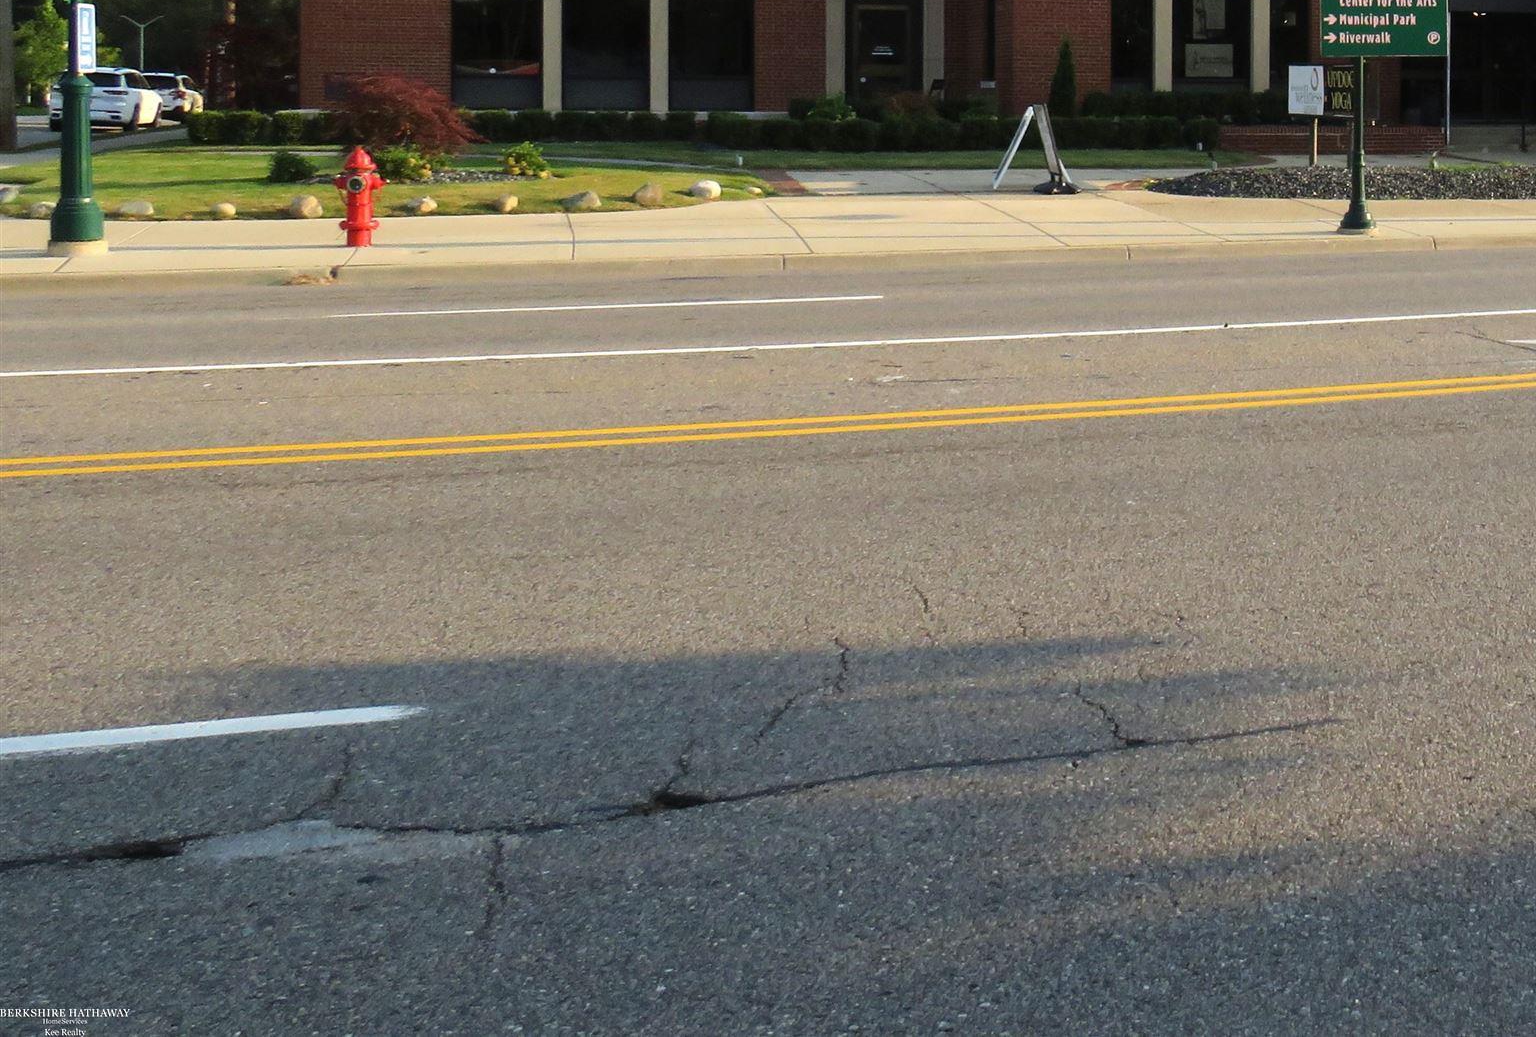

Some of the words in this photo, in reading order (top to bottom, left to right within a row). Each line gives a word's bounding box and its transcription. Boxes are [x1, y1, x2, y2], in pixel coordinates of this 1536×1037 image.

[1339, 13, 1389, 28] Municipal
[1393, 13, 1417, 26] Park
[1339, 31, 1391, 44] Riverwalk
[1330, 91, 1352, 110] YOGA
